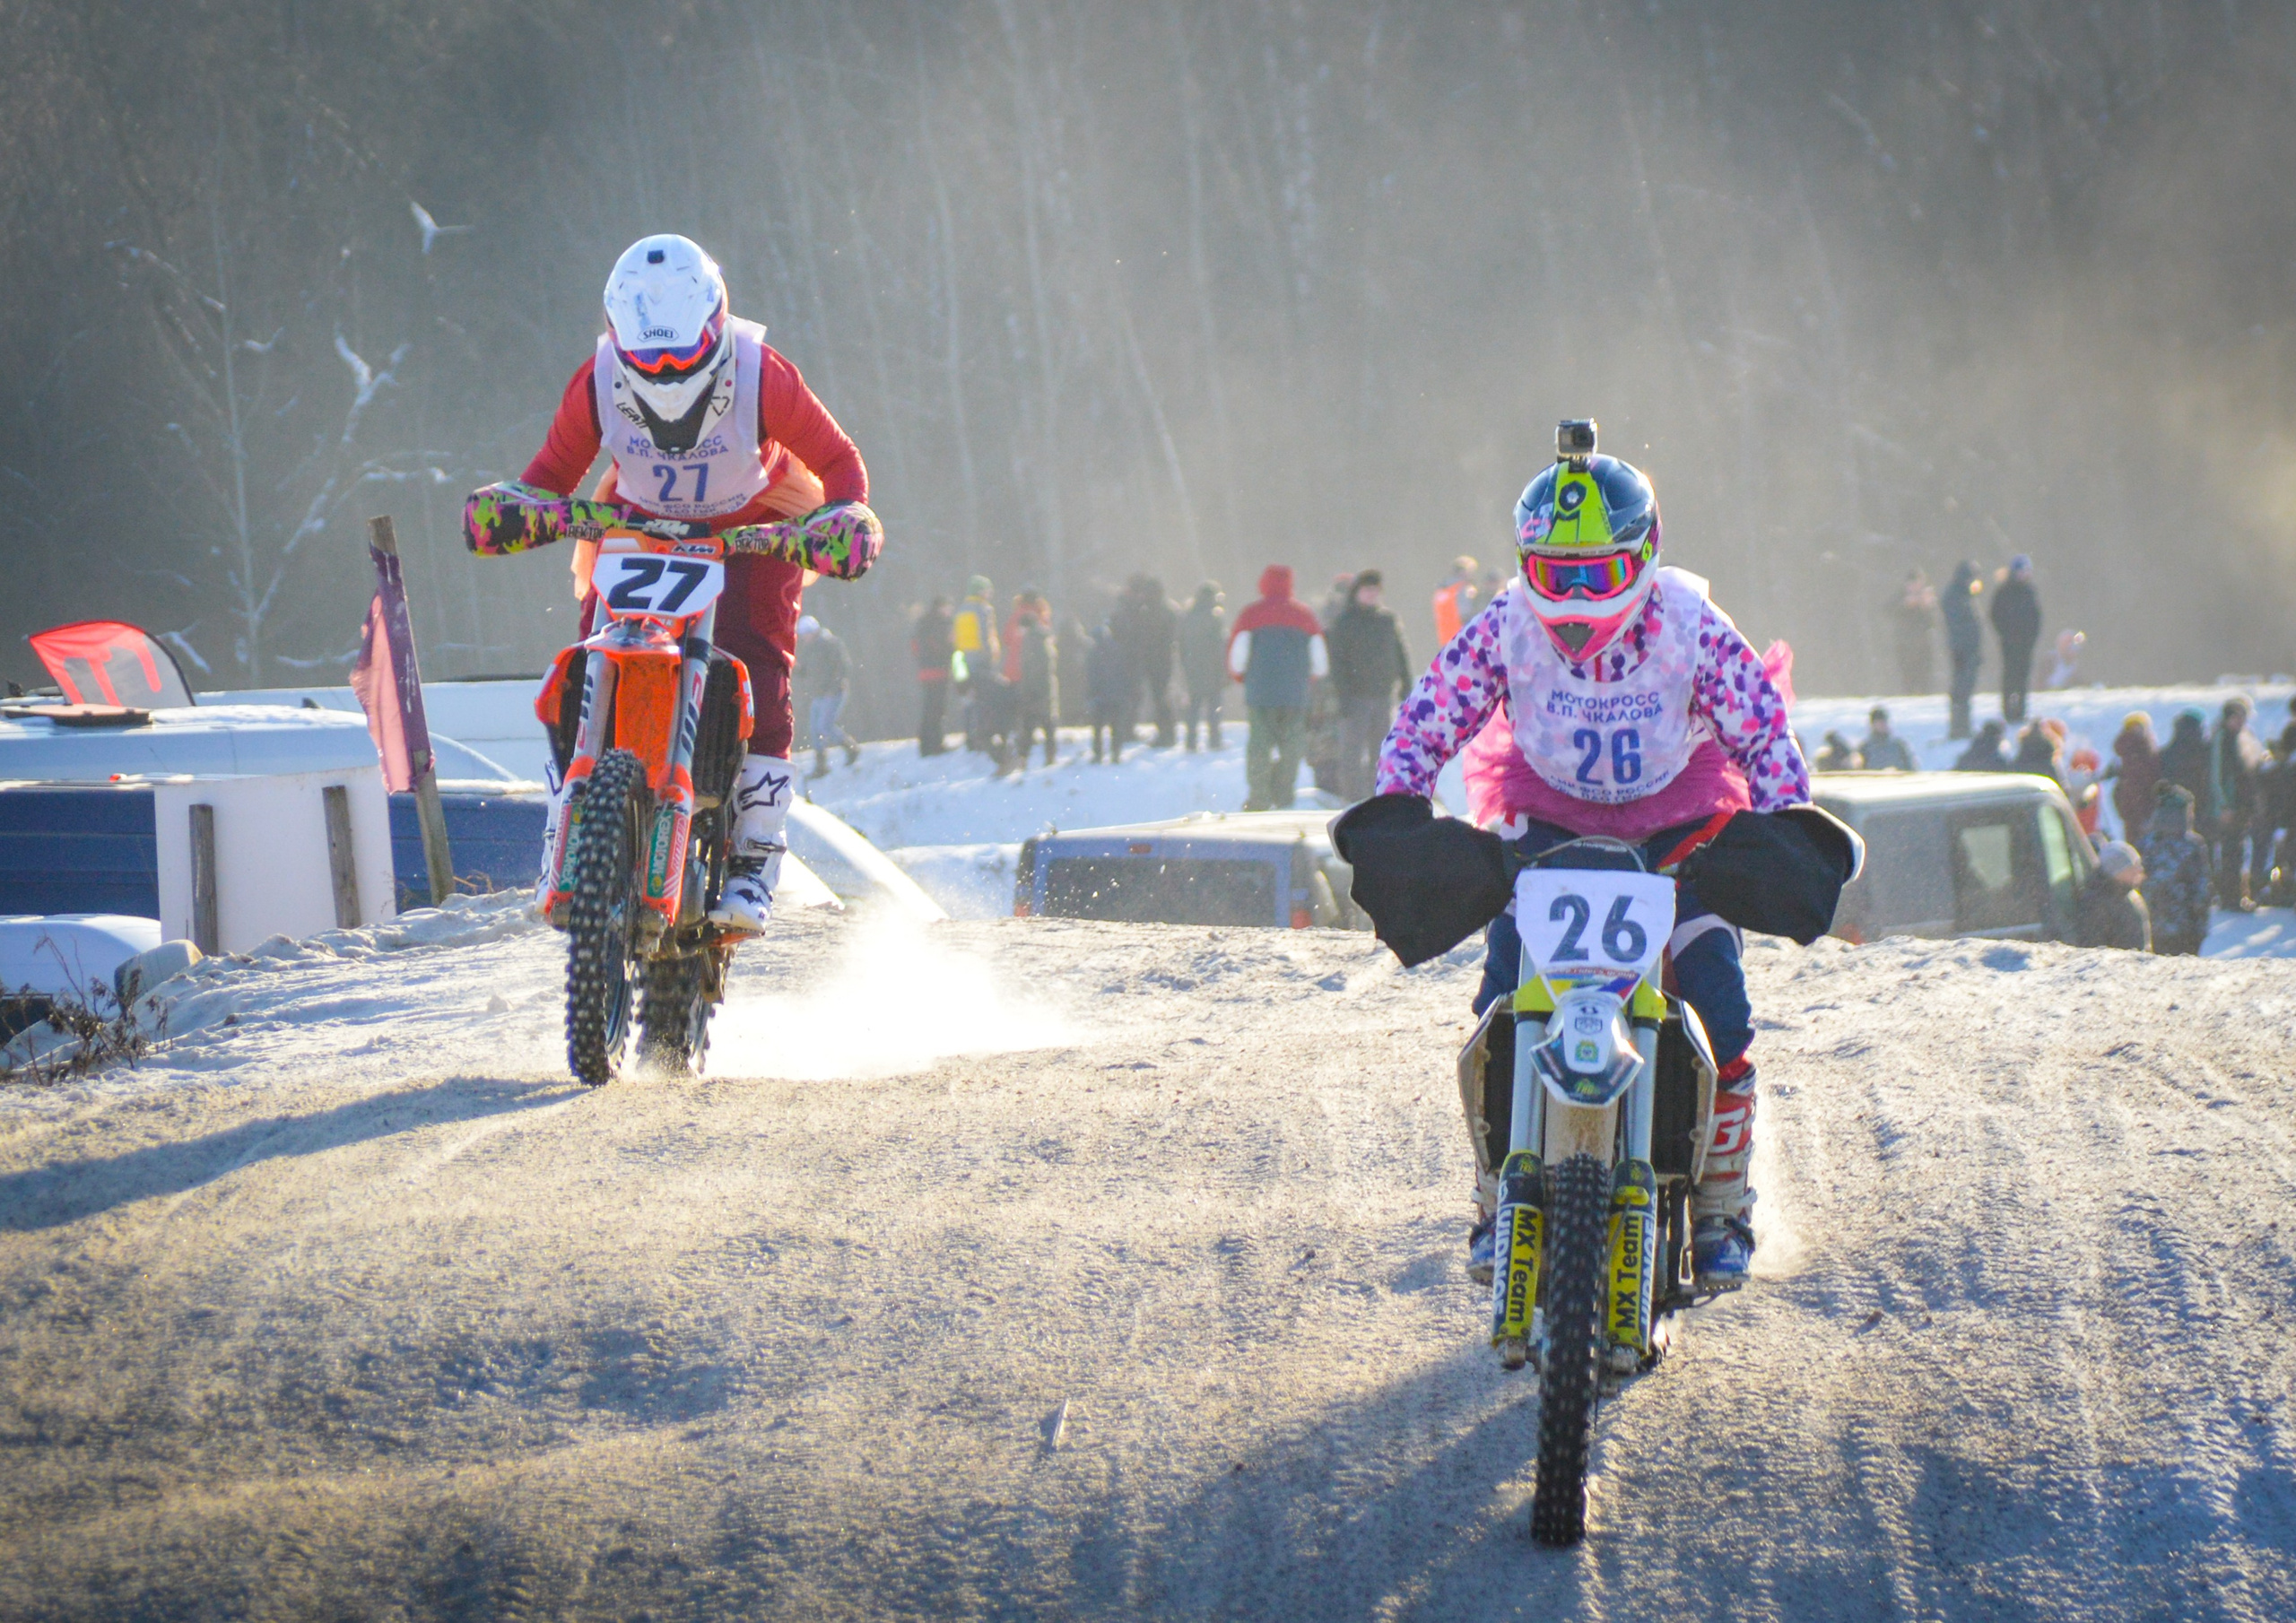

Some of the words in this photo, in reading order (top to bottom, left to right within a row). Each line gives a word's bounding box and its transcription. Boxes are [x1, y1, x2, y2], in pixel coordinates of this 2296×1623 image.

[643, 328, 674, 340] SHOEI
[657, 445, 729, 462] ЧКАЛОВА
[652, 463, 709, 502] 27
[642, 518, 691, 535] KTM
[607, 558, 709, 612] 27
[1547, 700, 1577, 717] В.П.
[1582, 703, 1663, 723] ЧКАЛОВА
[1551, 690, 1659, 709] МОТОКРОСС
[1573, 729, 1641, 785] 26
[561, 825, 581, 885] MOTOREX
[652, 814, 672, 874] MOTOREX
[1549, 894, 1647, 963] 26
[1516, 1208, 1538, 1250] MX
[1617, 1215, 1639, 1282] Team
[1509, 1257, 1534, 1323] Team
[1615, 1289, 1637, 1329] MX
